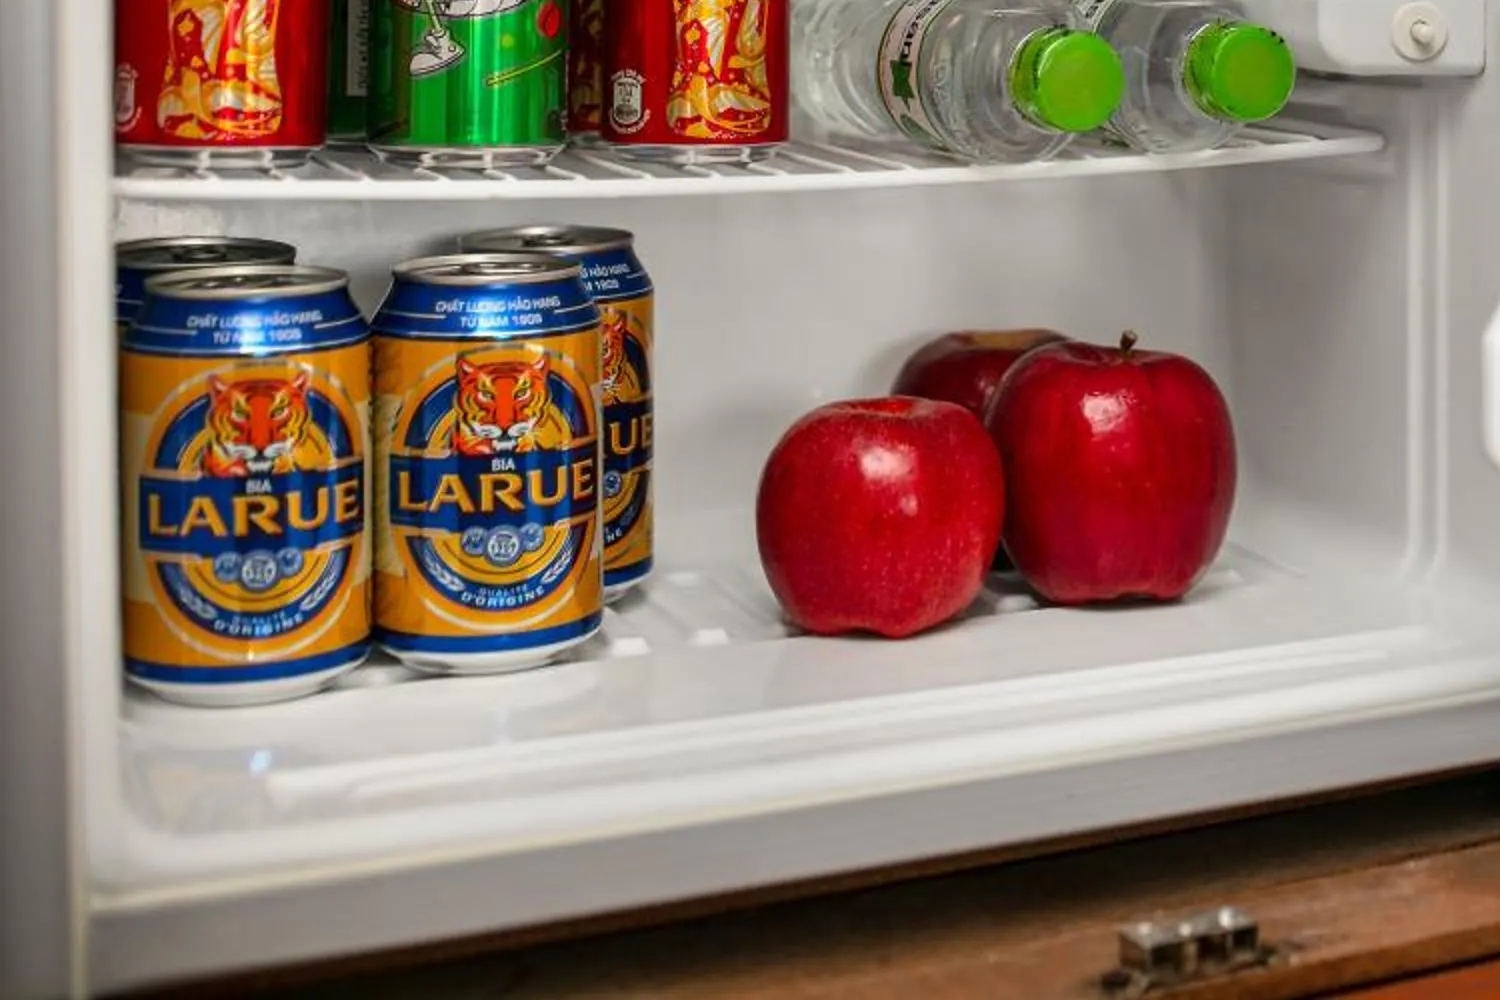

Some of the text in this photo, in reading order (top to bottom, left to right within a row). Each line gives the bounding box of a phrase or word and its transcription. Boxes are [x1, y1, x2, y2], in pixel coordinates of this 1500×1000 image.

[398, 459, 594, 513] LARUE
[491, 458, 515, 472] BIA
[147, 478, 359, 537] LARUE
